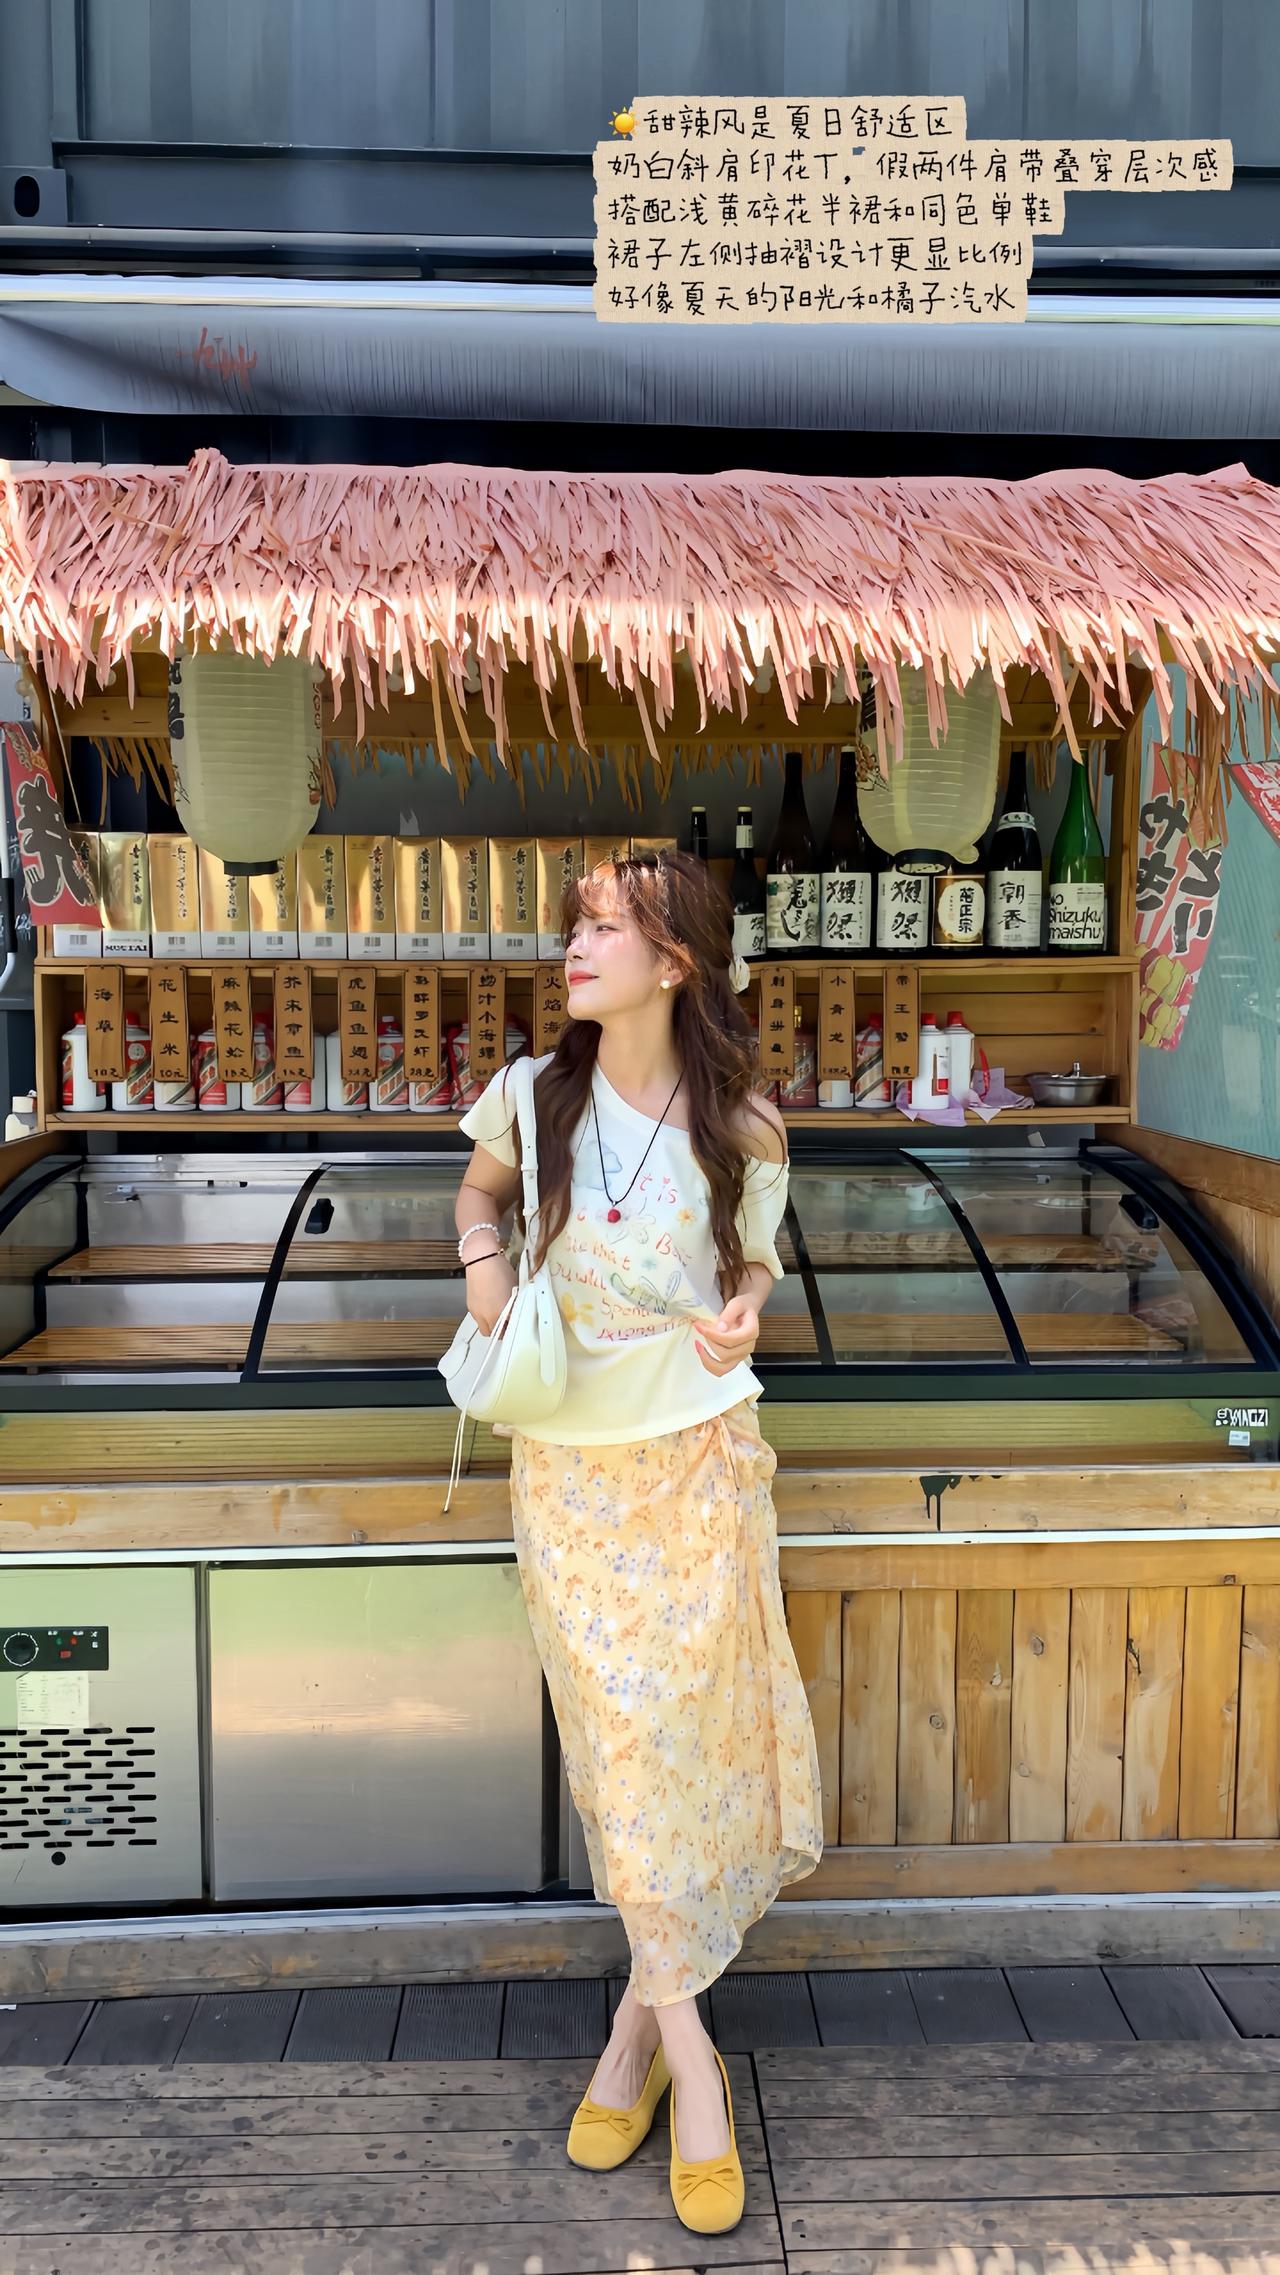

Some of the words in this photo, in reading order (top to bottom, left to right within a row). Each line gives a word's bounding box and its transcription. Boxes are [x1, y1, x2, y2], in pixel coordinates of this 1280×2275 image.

[958, 886, 975, 934] 菊正宗
[94, 987, 114, 1033] 海草
[157, 978, 180, 1056] 花生米
